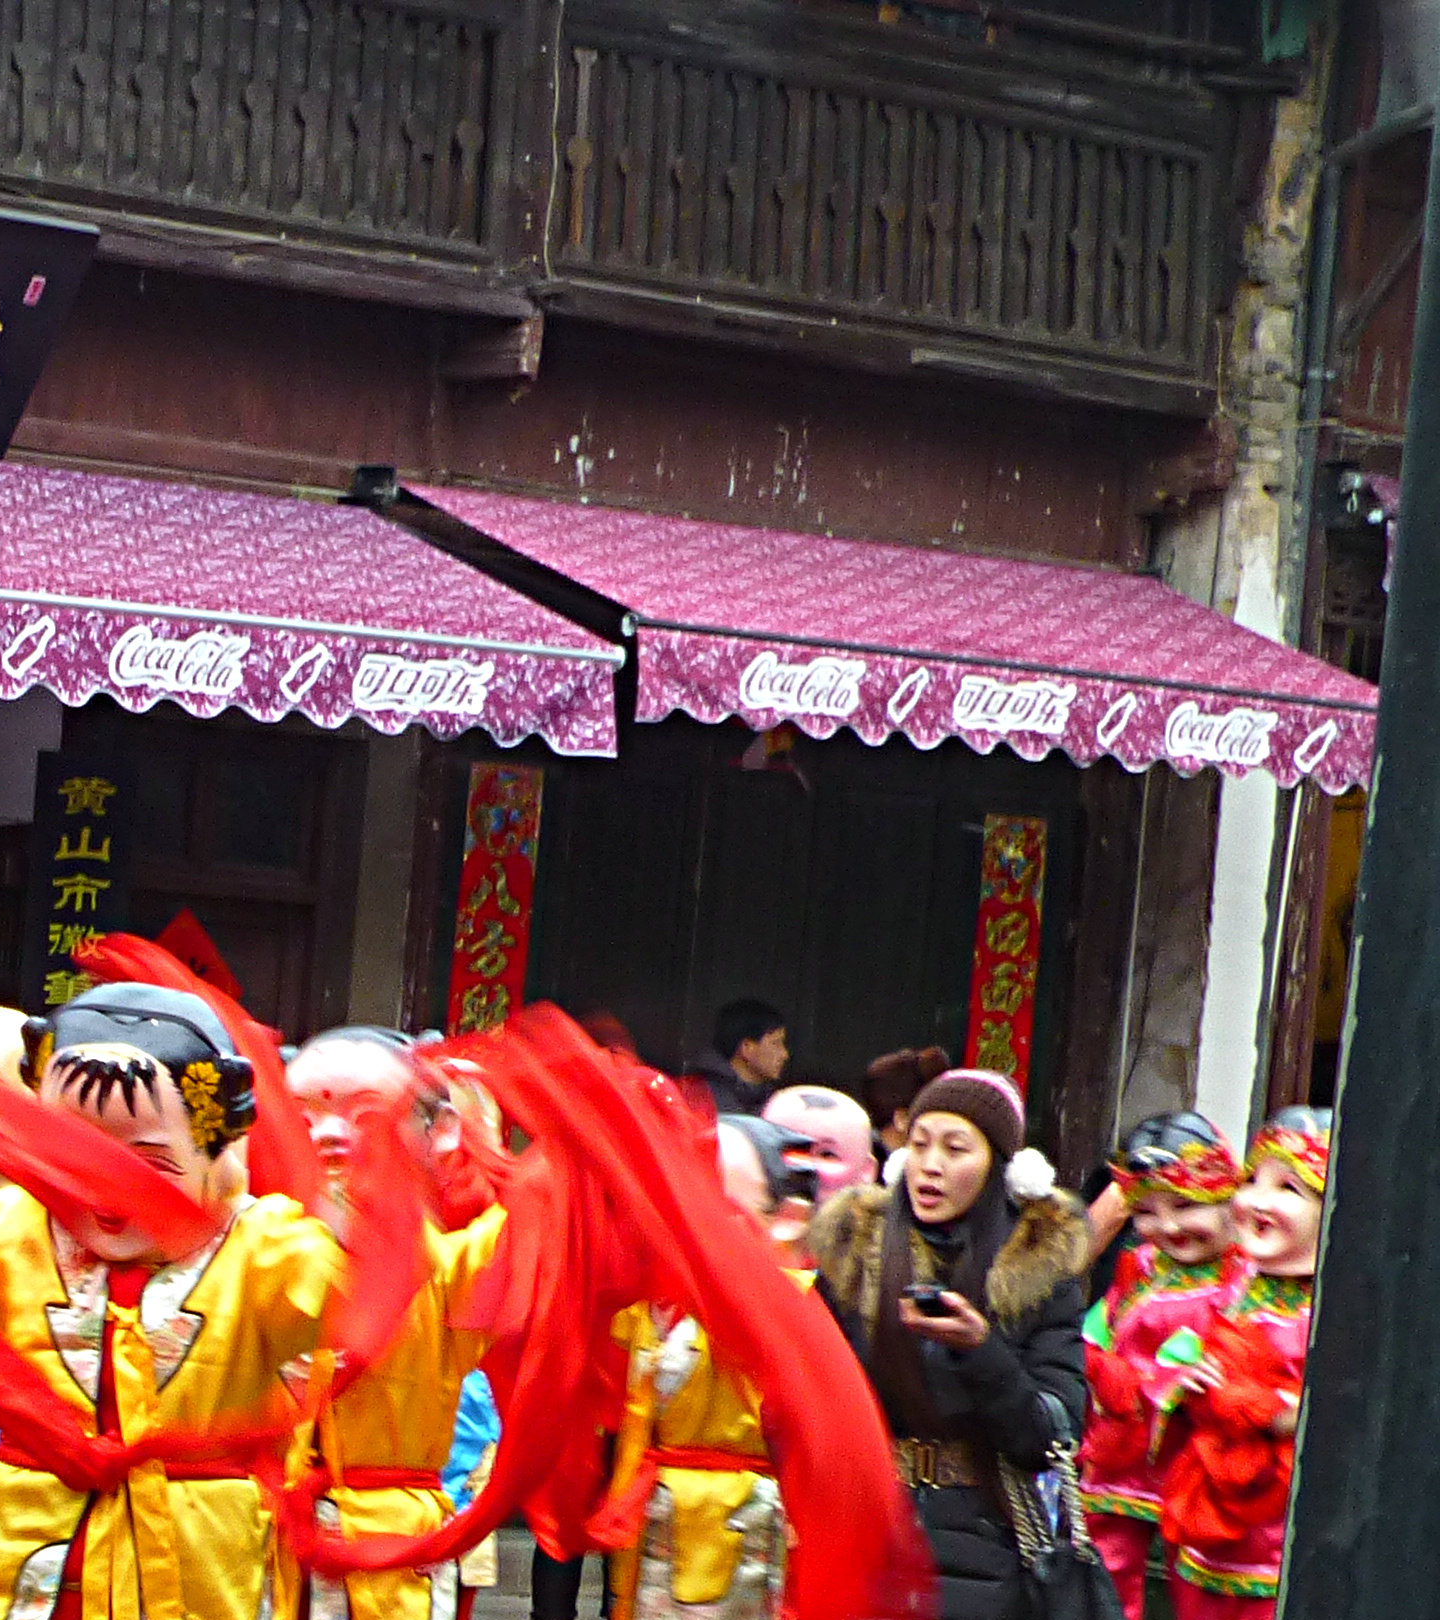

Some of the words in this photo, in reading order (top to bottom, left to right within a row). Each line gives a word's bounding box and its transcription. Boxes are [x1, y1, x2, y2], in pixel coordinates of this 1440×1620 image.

[356, 657, 488, 708] 可口可乐
[956, 680, 1071, 729] 可口可乐
